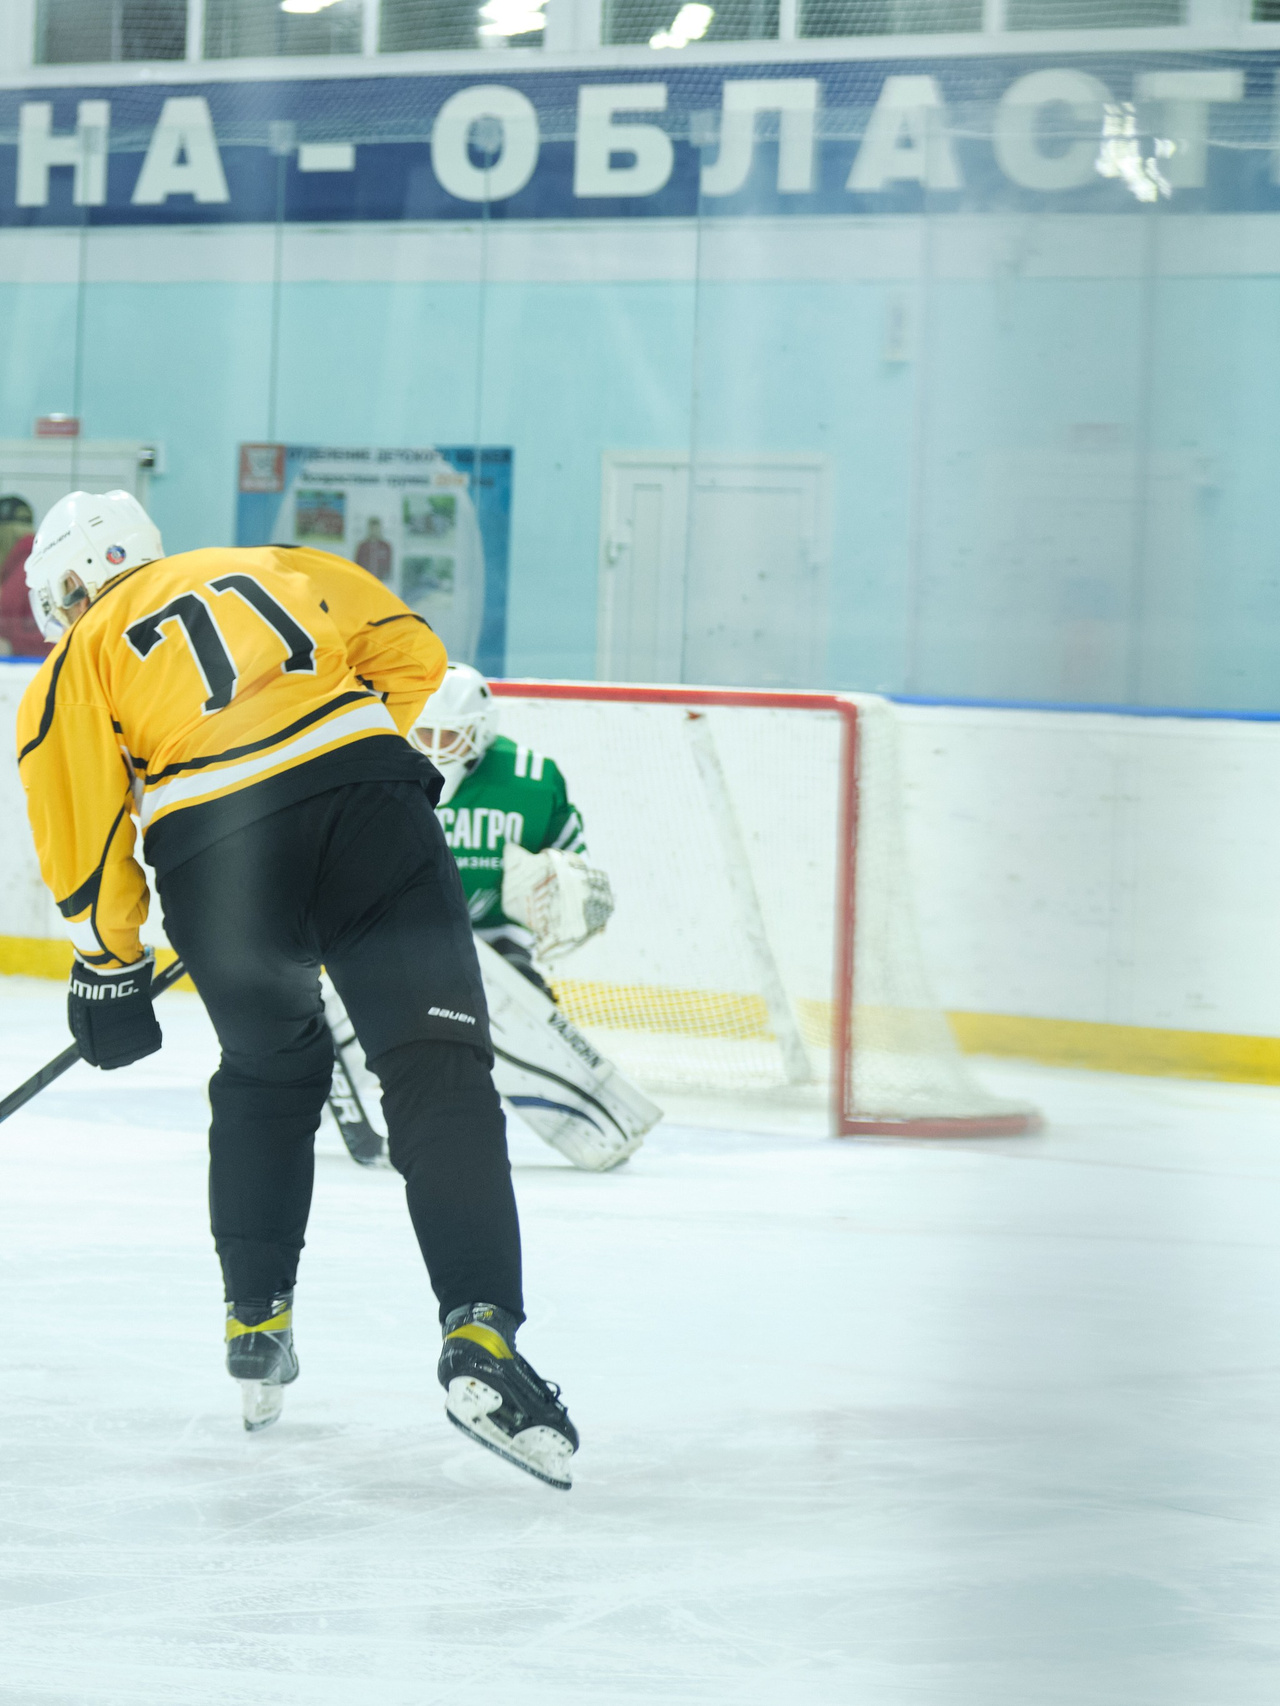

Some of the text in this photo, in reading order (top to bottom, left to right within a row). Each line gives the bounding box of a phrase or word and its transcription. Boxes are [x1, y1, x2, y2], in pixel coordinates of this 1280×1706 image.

[430, 67, 1280, 202] ОБЛАСТ
[122, 572, 317, 716] 71
[434, 808, 524, 850] САГРО
[454, 856, 504, 870] ИЗНЕ
[547, 1011, 602, 1069] VAUGHN
